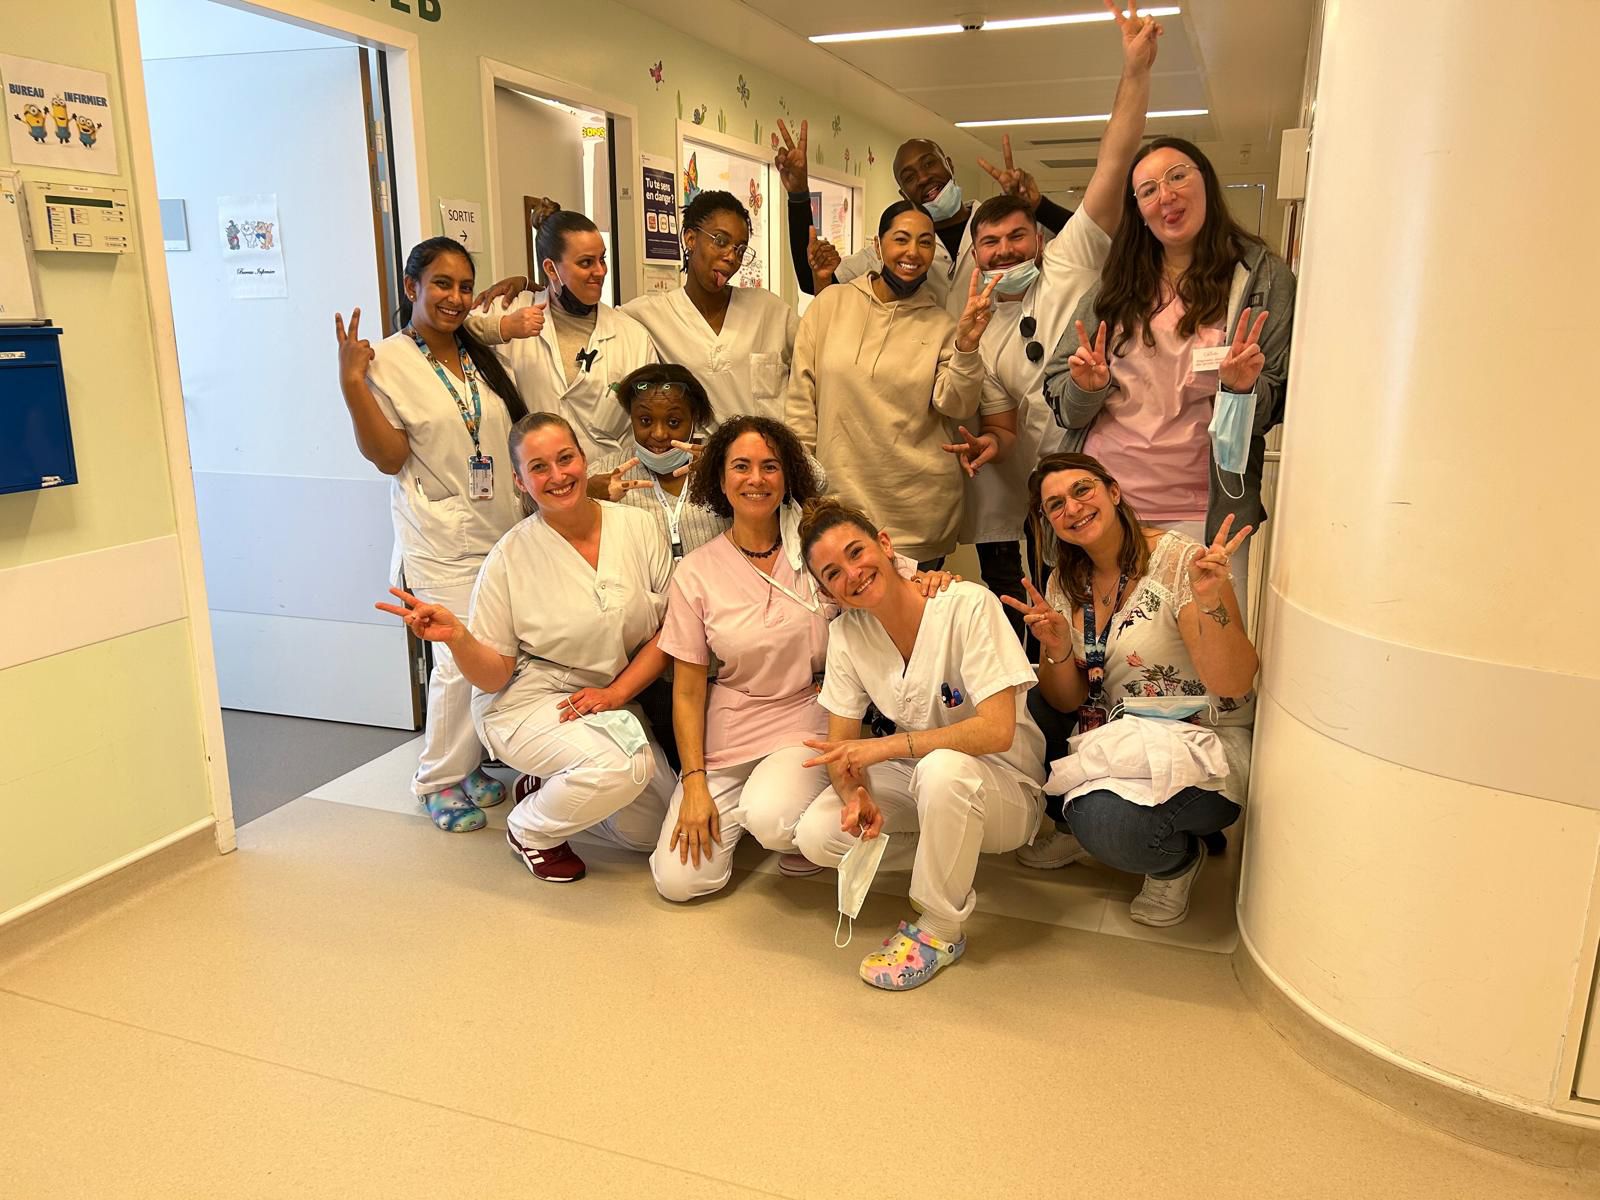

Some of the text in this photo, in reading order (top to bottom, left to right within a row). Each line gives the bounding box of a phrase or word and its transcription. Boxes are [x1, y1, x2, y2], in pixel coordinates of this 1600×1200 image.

[9, 83, 108, 107] BUREAU INFIRMIER
[645, 177, 654, 189] Tu
[448, 209, 475, 223] SORTIE
